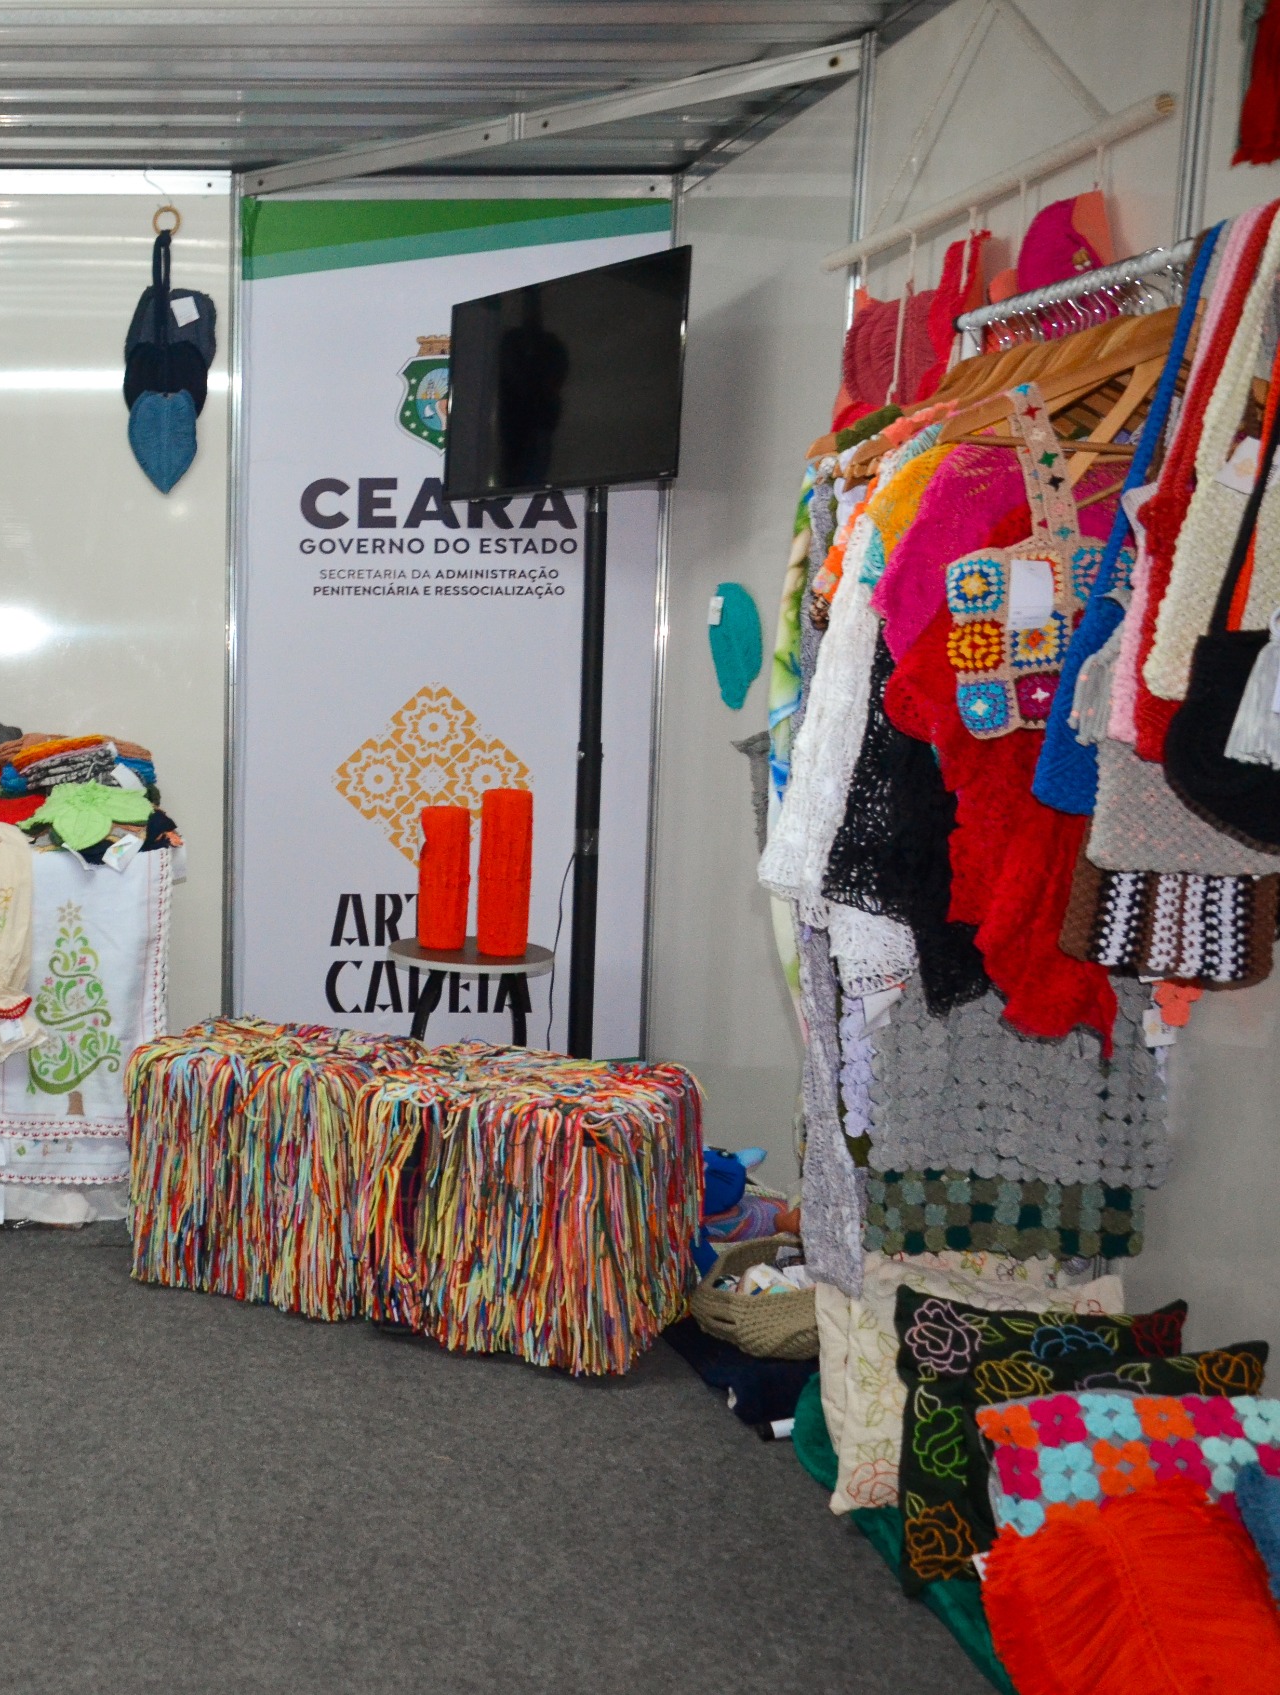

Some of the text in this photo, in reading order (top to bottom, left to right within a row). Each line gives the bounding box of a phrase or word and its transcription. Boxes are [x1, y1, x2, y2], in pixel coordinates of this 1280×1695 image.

[299, 537, 579, 555] GOVERNO DO ESTADO
[319, 566, 560, 583] SECRETARIA DA ADMINISTRAÇÃO
[313, 582, 566, 599] PENITENCIÁRIA E RESSOCIALIZAÇÃO
